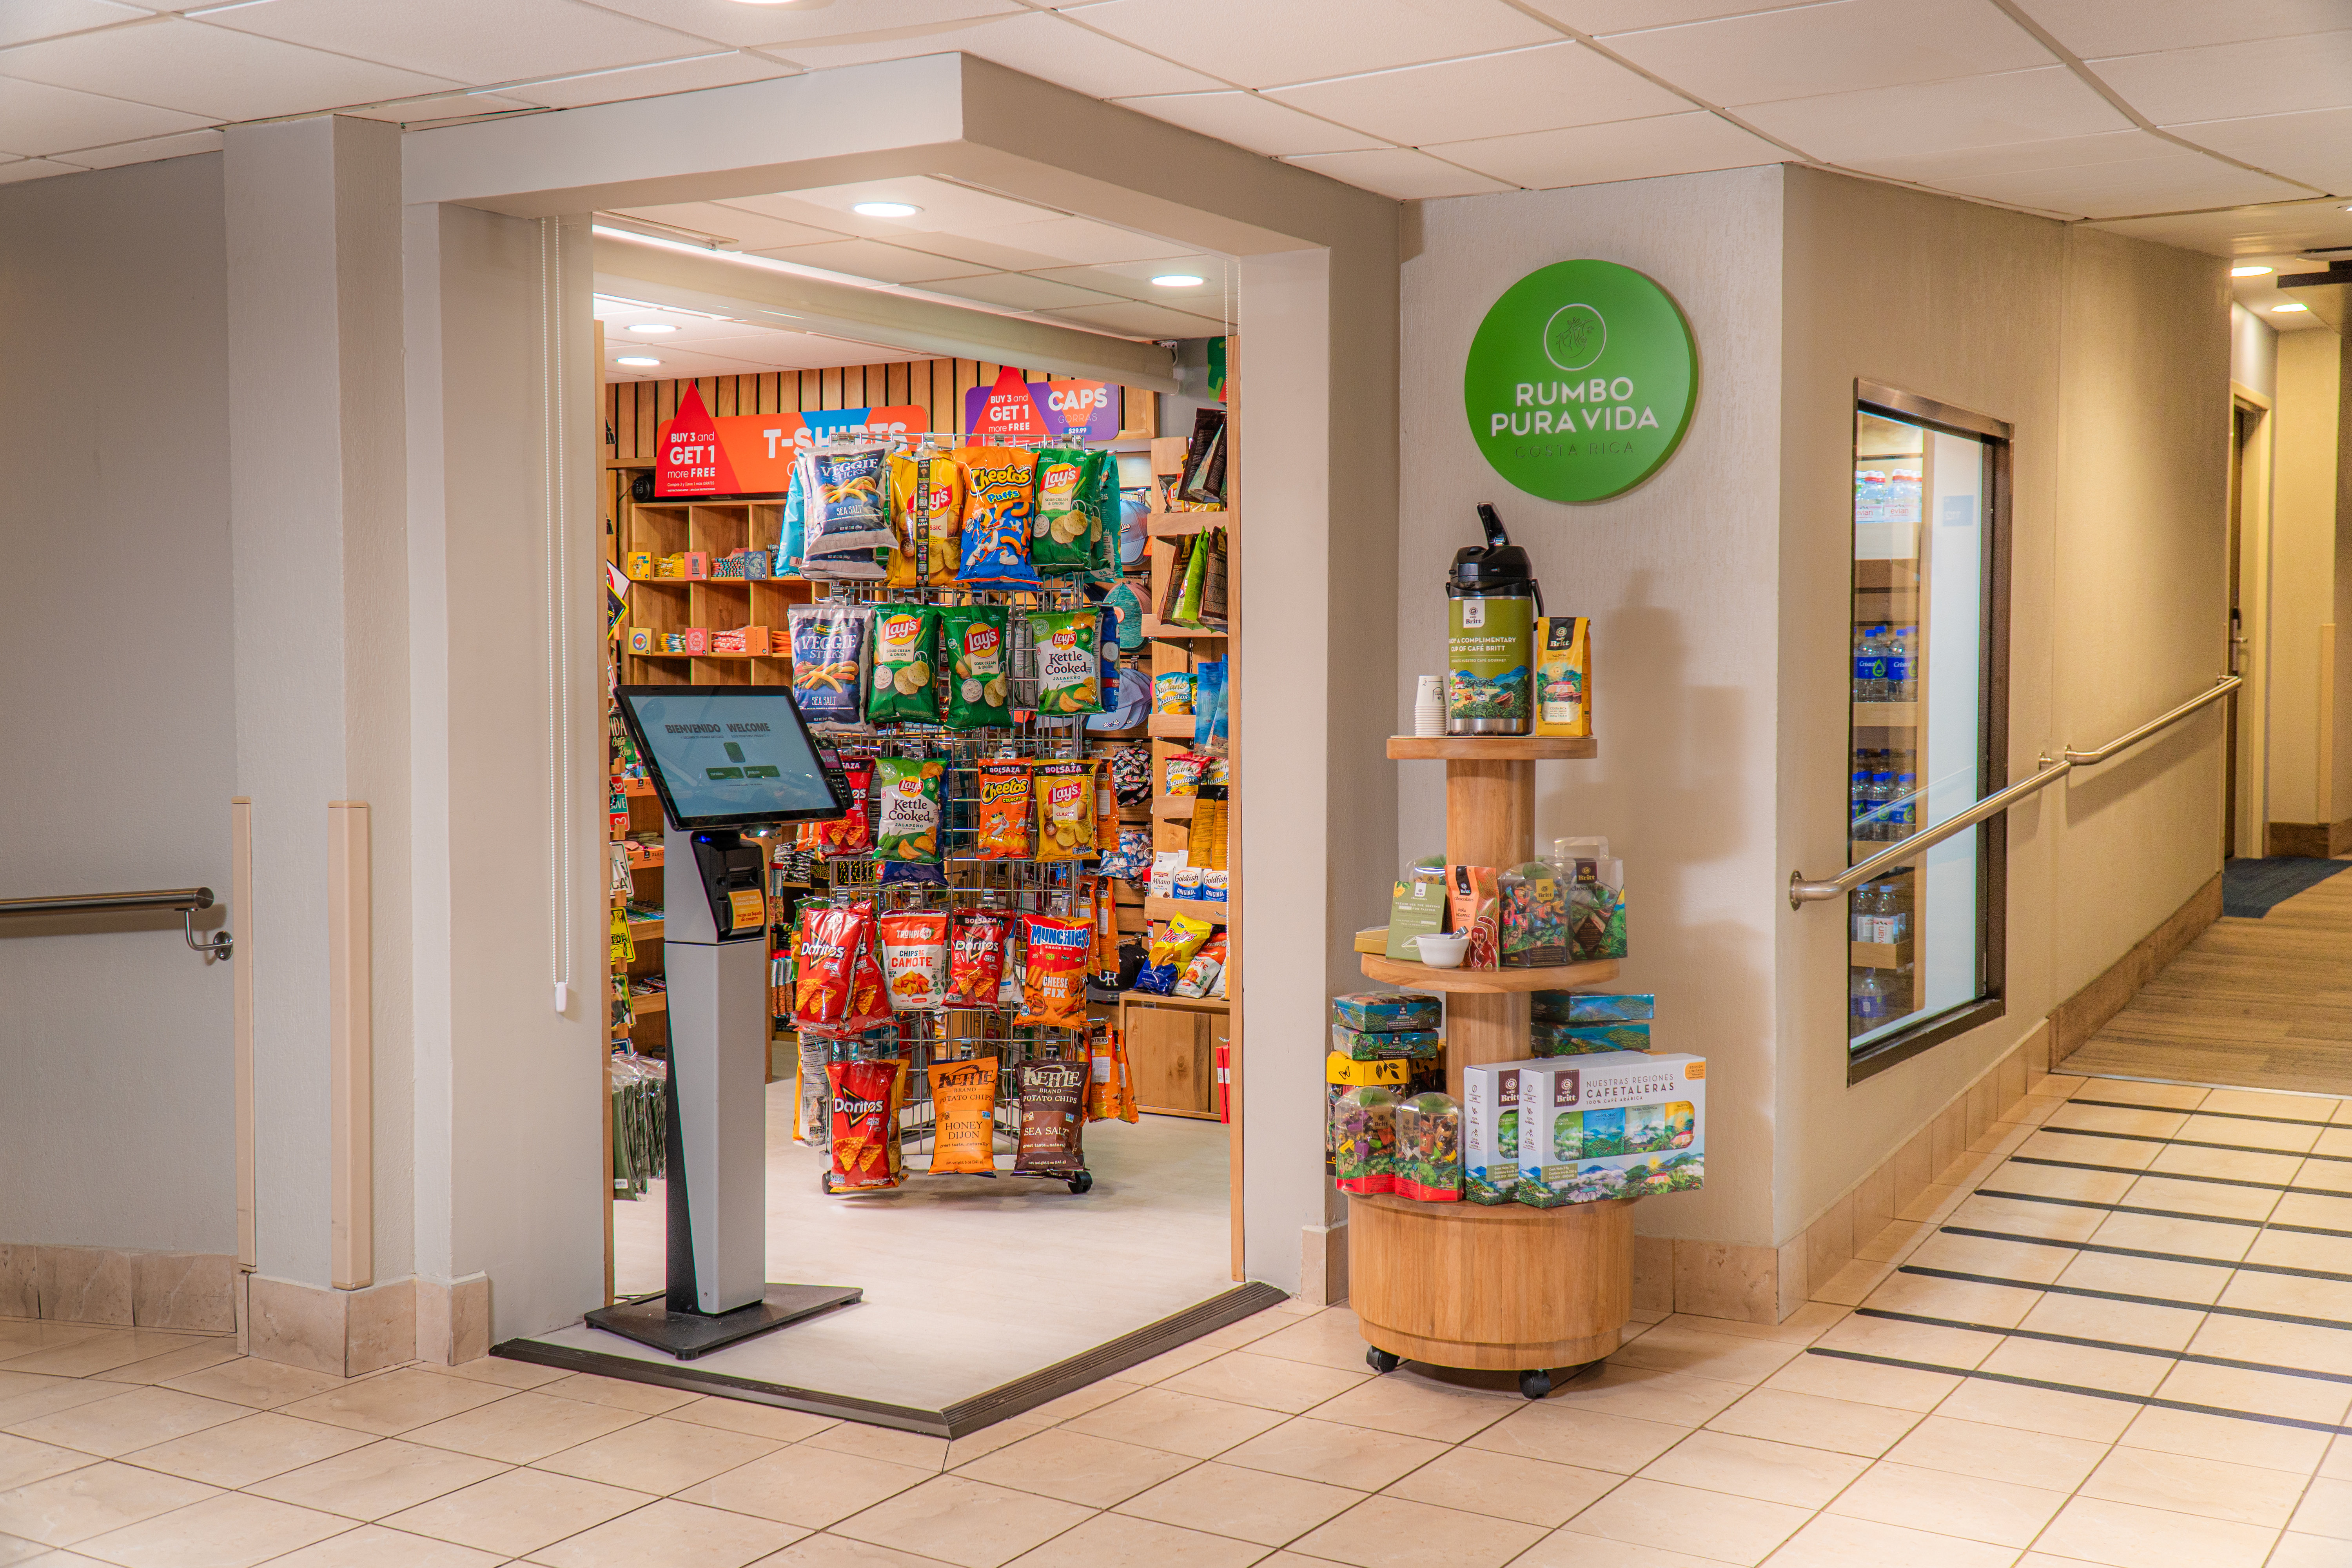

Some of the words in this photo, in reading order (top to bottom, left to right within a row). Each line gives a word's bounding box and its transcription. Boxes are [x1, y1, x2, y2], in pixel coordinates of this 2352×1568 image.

[1515, 376, 1634, 407] RUMBO
[991, 396, 1005, 404] BUY
[1013, 394, 1028, 402] and
[1048, 388, 1107, 411] CAPS
[990, 405, 1019, 421] GET
[1023, 405, 1029, 419] 1
[1058, 413, 1097, 423] GORRAS
[1009, 422, 1030, 430] FREE
[1491, 410, 1577, 437] PURA
[1581, 405, 1659, 430] VIDA
[671, 433, 688, 443] BUY
[690, 432, 695, 442] 3
[698, 431, 714, 441] and
[763, 422, 907, 458] T-SHRTS
[670, 446, 704, 465] GET
[708, 445, 714, 463] 1
[1515, 445, 1577, 458] COSTA
[1590, 441, 1633, 455] RICA
[691, 467, 715, 477] FREE
[820, 459, 878, 477] VEGGIE
[832, 468, 866, 483] STICKS
[971, 465, 1031, 492] Cheetos
[1045, 469, 1075, 487] Lay's
[987, 490, 1020, 503] Puffs
[837, 507, 847, 516] SEA
[849, 505, 862, 515] SALT
[885, 620, 916, 639] Lay's
[801, 635, 856, 650] VEGGIE
[970, 629, 997, 652] Lay's
[1053, 632, 1075, 644] Lay's
[809, 649, 844, 659] STICKS
[1049, 651, 1082, 665] Kettle
[1045, 662, 1087, 675] Cooked
[812, 697, 822, 705] SEA
[823, 696, 836, 705] SALT
[1157, 693, 1189, 706] Maduritos
[665, 724, 720, 733] BIENVENIDO
[726, 723, 771, 732] WELCOME
[1045, 764, 1082, 773] BOLSAZA
[982, 778, 1029, 804] Cheetos
[1053, 784, 1078, 802] Lay's
[894, 799, 927, 811] Kettle
[888, 810, 929, 822] Cooked
[1175, 873, 1198, 882] Goldfish
[1204, 874, 1227, 884] Goldfish
[801, 942, 845, 958] Doritos
[955, 940, 998, 951] Doritos
[891, 957, 933, 967] CAMOTE
[1043, 976, 1068, 987] CHEESE
[1043, 988, 1066, 998] FIX
[938, 1066, 996, 1088] KETTLE
[1023, 1065, 1081, 1087] KETTLE
[1586, 1078, 1628, 1087] NUESTRAS
[1632, 1074, 1674, 1083] REGIONES
[1586, 1082, 1674, 1098] CAFETALERAS
[940, 1095, 967, 1103] POTATO
[1557, 1094, 1577, 1103] Britt
[835, 1098, 884, 1113] Doritos
[946, 1122, 983, 1131] HONEY
[1024, 1127, 1042, 1136] SEA
[1045, 1127, 1069, 1136] SALT
[949, 1131, 979, 1140] DIJON
